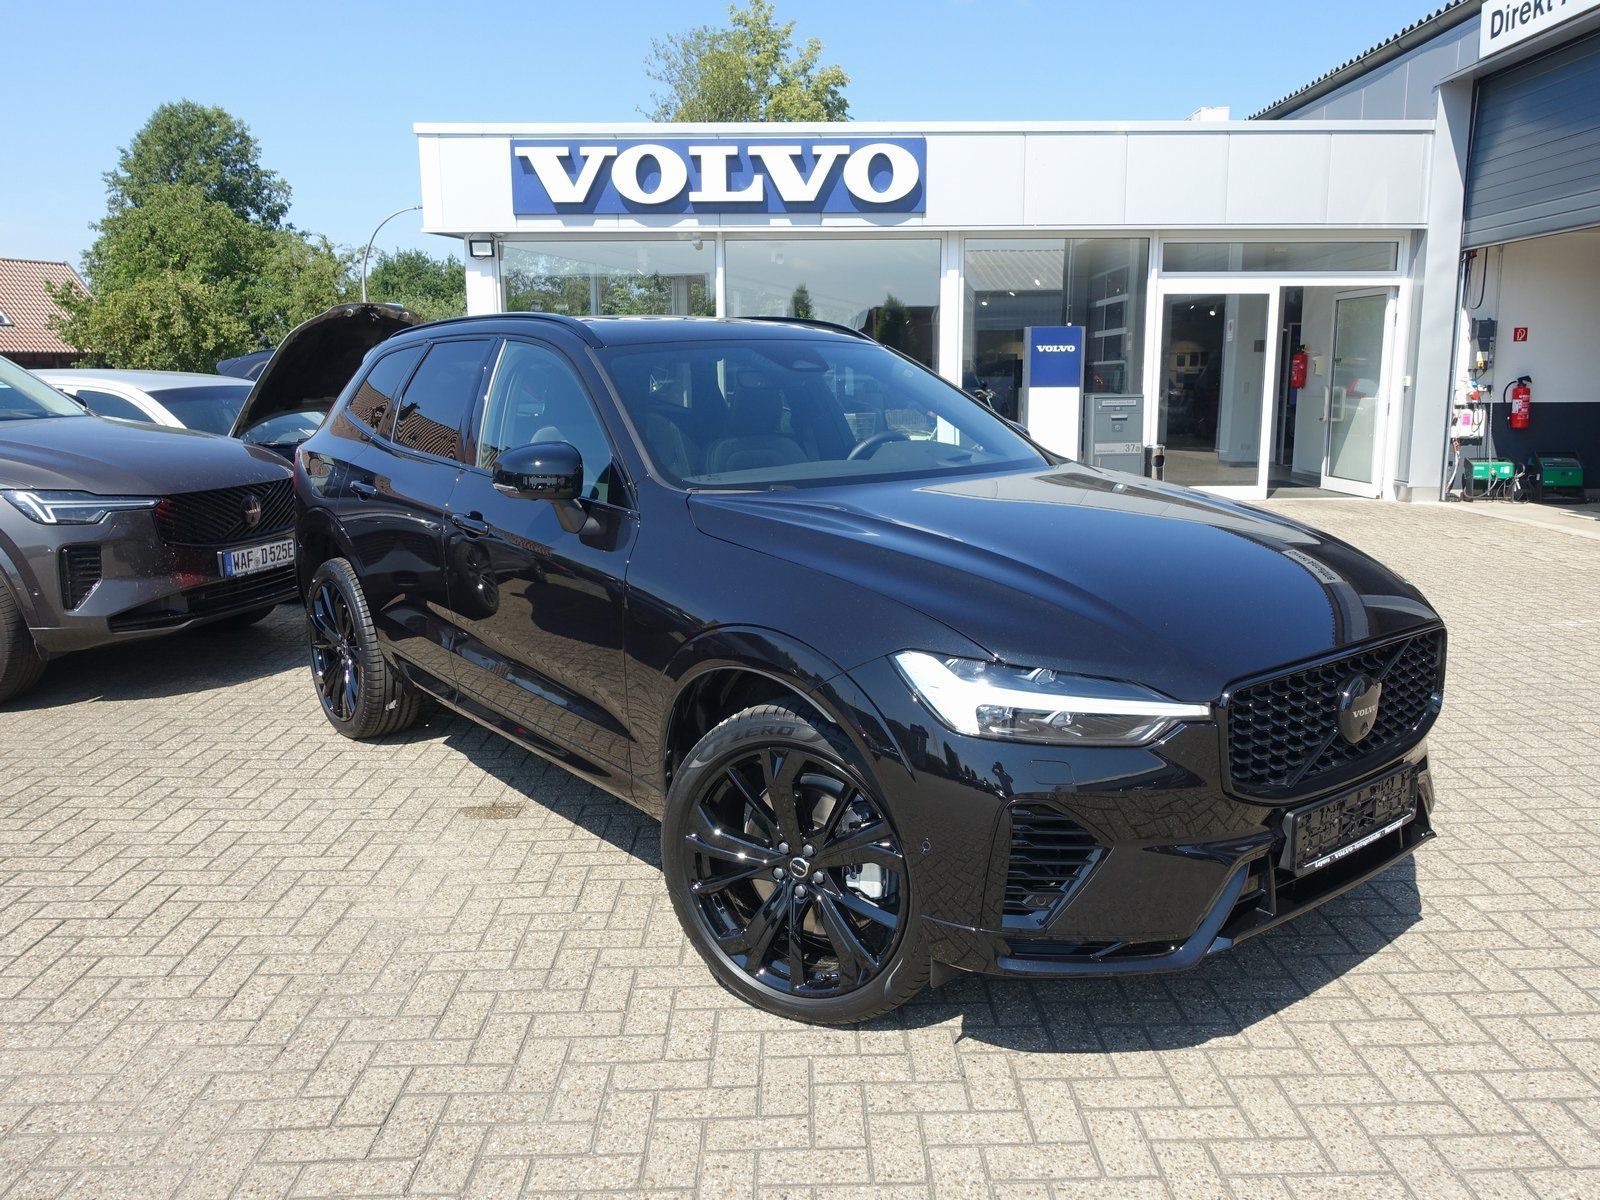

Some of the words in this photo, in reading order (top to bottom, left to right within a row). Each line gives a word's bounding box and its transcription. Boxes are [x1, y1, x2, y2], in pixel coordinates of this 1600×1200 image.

[514, 142, 920, 204] VOLVO
[1036, 345, 1076, 353] VOLVO
[1125, 444, 1141, 453] 37a
[232, 550, 254, 571] WAF
[269, 541, 294, 562] 525E
